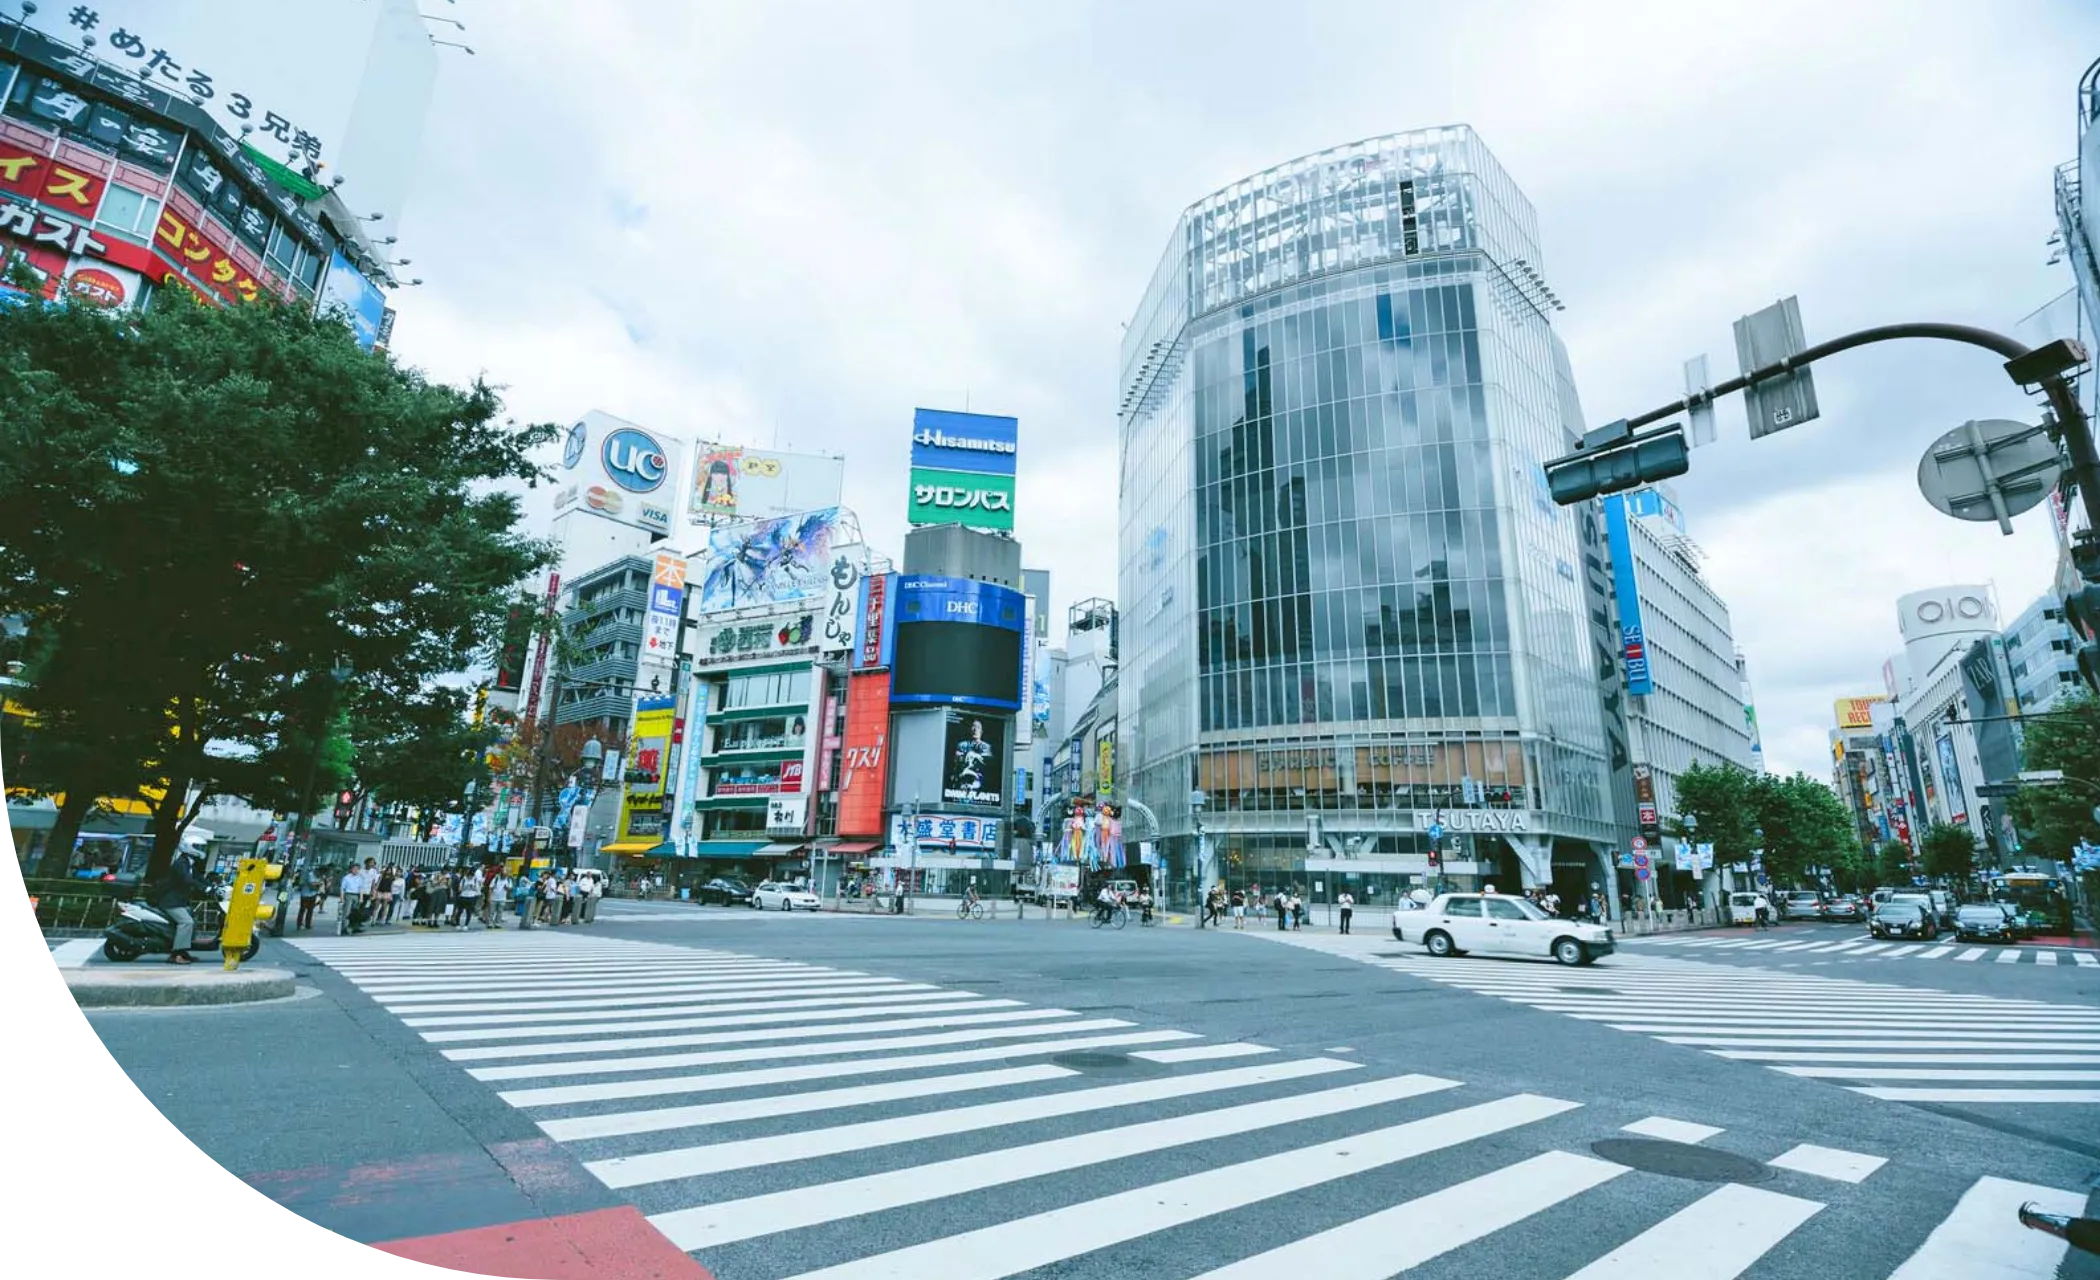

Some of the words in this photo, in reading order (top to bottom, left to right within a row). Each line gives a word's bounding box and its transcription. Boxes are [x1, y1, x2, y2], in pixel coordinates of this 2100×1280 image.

[913, 428, 1016, 453] Hisamitsu
[914, 484, 1011, 512] サロンパス
[641, 507, 669, 524] VISA
[655, 556, 686, 588] 本
[825, 554, 858, 647] もんじゃ
[947, 601, 979, 613] DHC
[1580, 500, 1629, 771] SUTAYA
[1622, 624, 1648, 682] SEIBU
[1418, 811, 1527, 831] TSUTAYA
